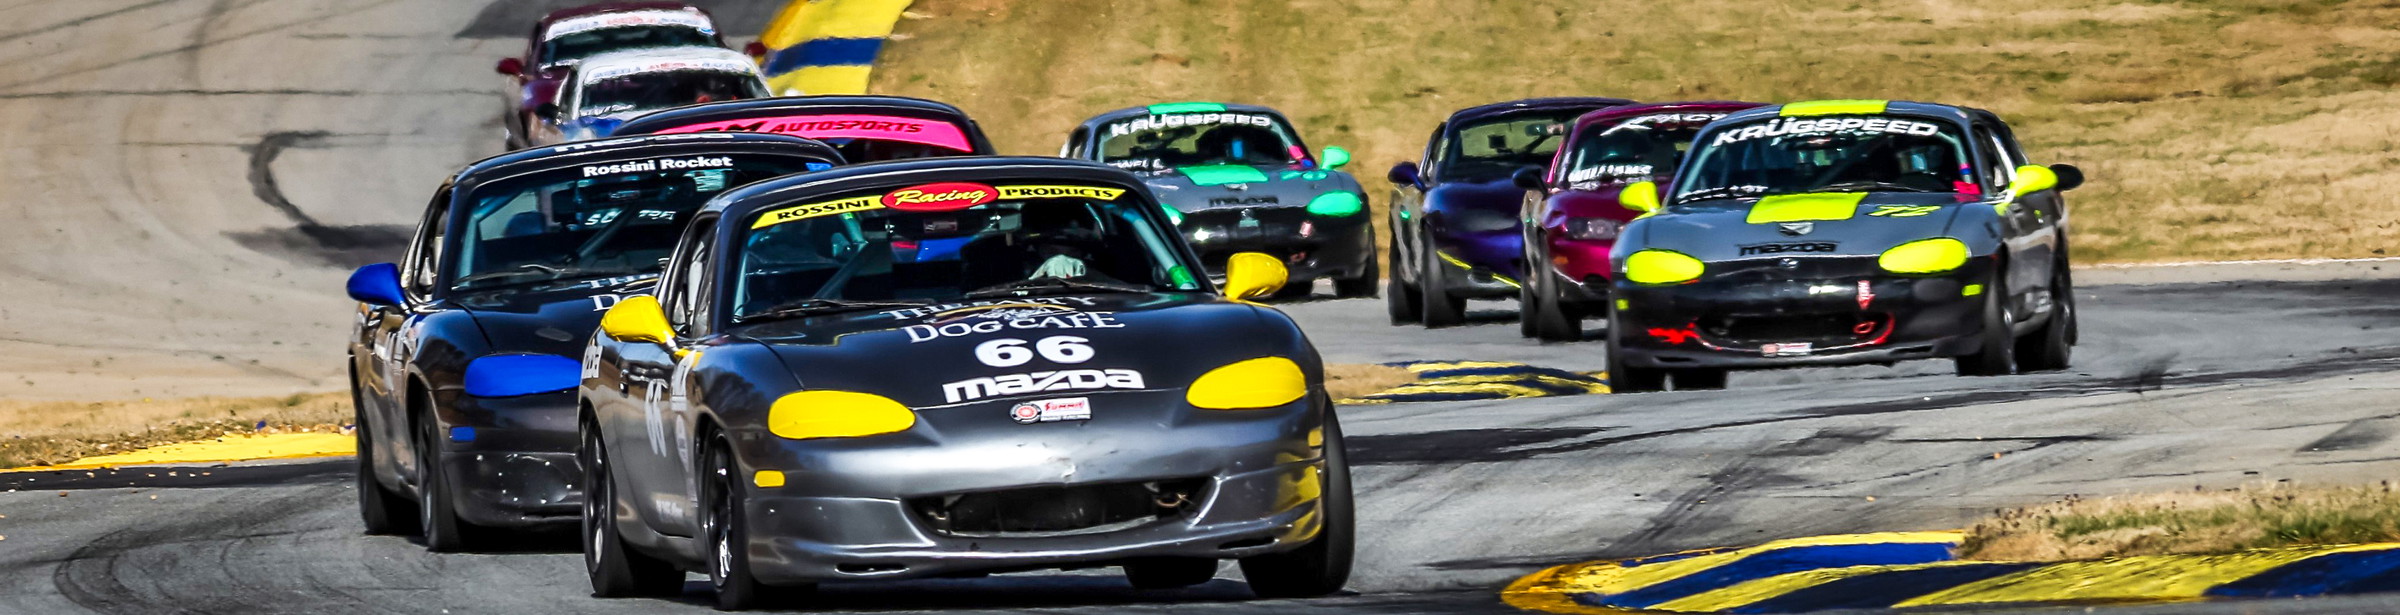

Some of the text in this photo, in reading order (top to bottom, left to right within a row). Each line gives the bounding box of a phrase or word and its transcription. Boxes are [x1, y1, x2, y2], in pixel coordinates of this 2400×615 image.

[769, 120, 924, 134] AUTOSPORTS
[583, 156, 733, 178] Rossini Rocket
[777, 187, 1114, 220] ROSSINI Racing PRODUCTS
[1738, 241, 1838, 256] mazda
[902, 319, 1004, 344] DOG
[1008, 311, 1126, 330] CAFE
[975, 335, 1095, 368] 66
[942, 368, 1146, 404] mazda
